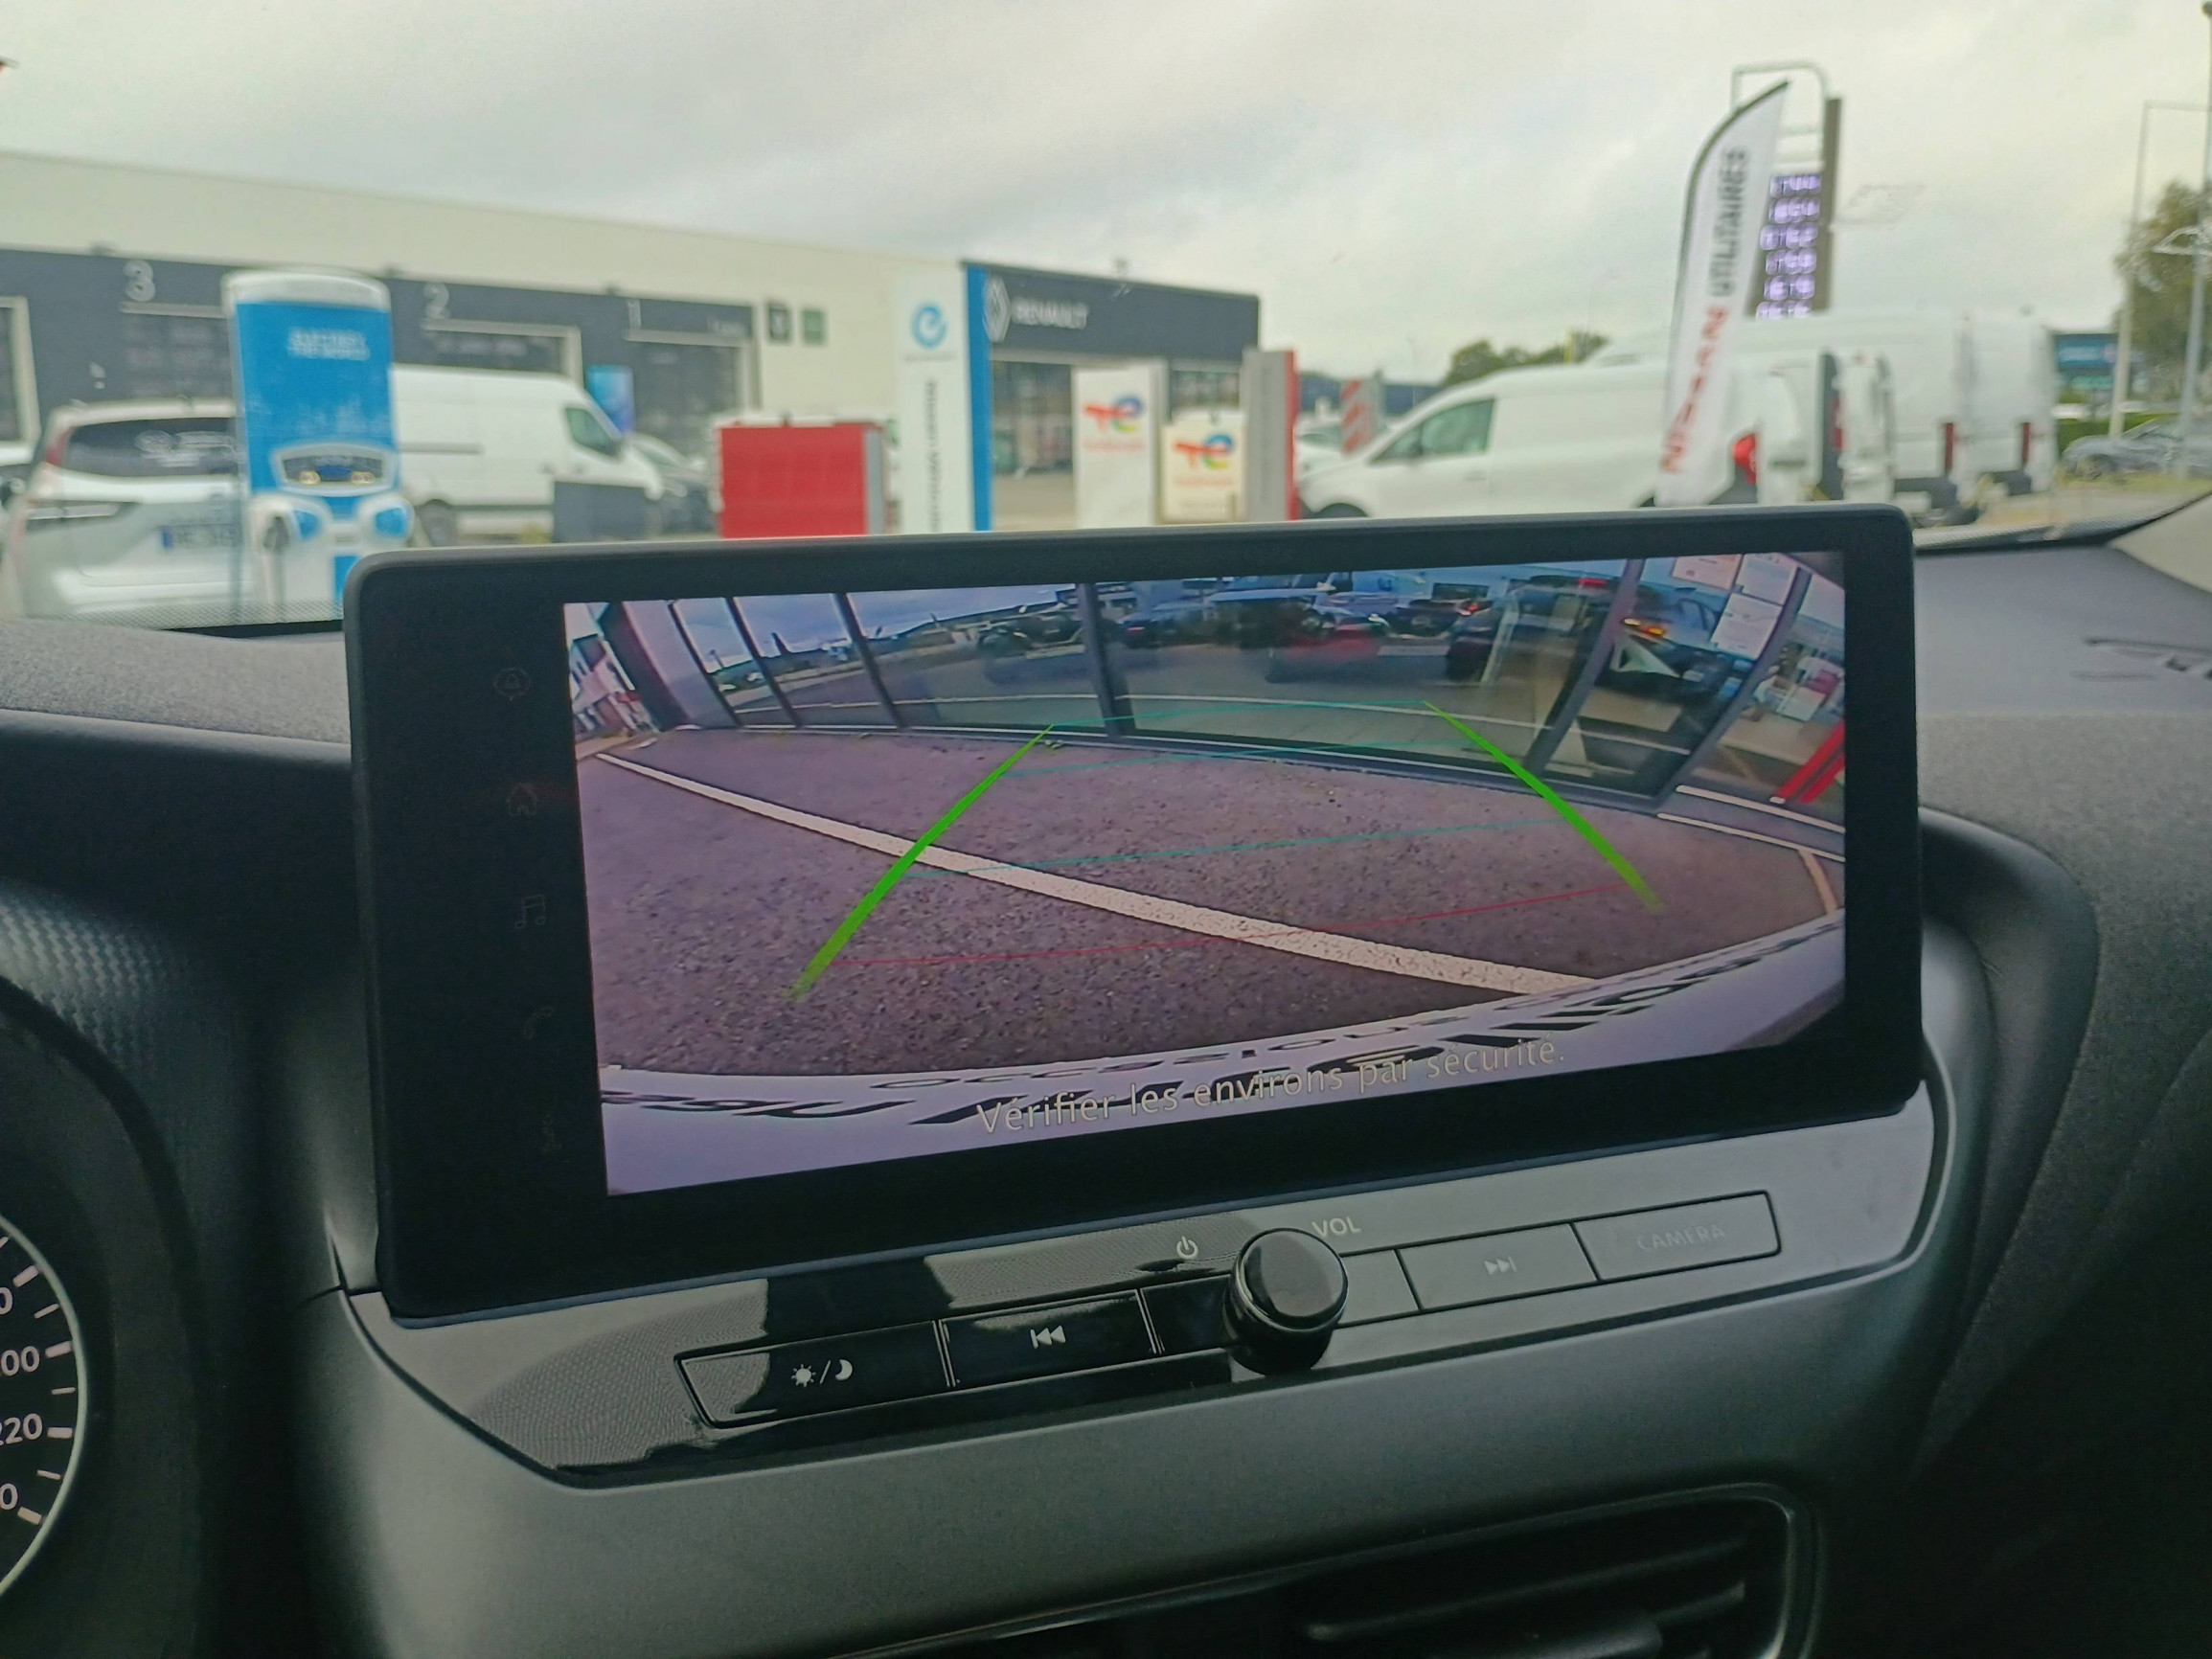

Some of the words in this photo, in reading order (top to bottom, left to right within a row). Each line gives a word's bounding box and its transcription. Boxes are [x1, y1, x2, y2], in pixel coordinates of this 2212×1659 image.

[1706, 148, 1750, 297] UTILITAIRES
[976, 1088, 1117, 1134] Vérifier
[1129, 1082, 1179, 1115] les
[1194, 1065, 1343, 1106] environs
[1358, 1054, 1413, 1094] par
[1425, 1035, 1566, 1079] sécurité.
[1311, 1216, 1361, 1239] VOL
[1636, 1223, 1727, 1252] CAMERA
[0, 1346, 40, 1376] 00
[0, 1413, 43, 1446] 20
